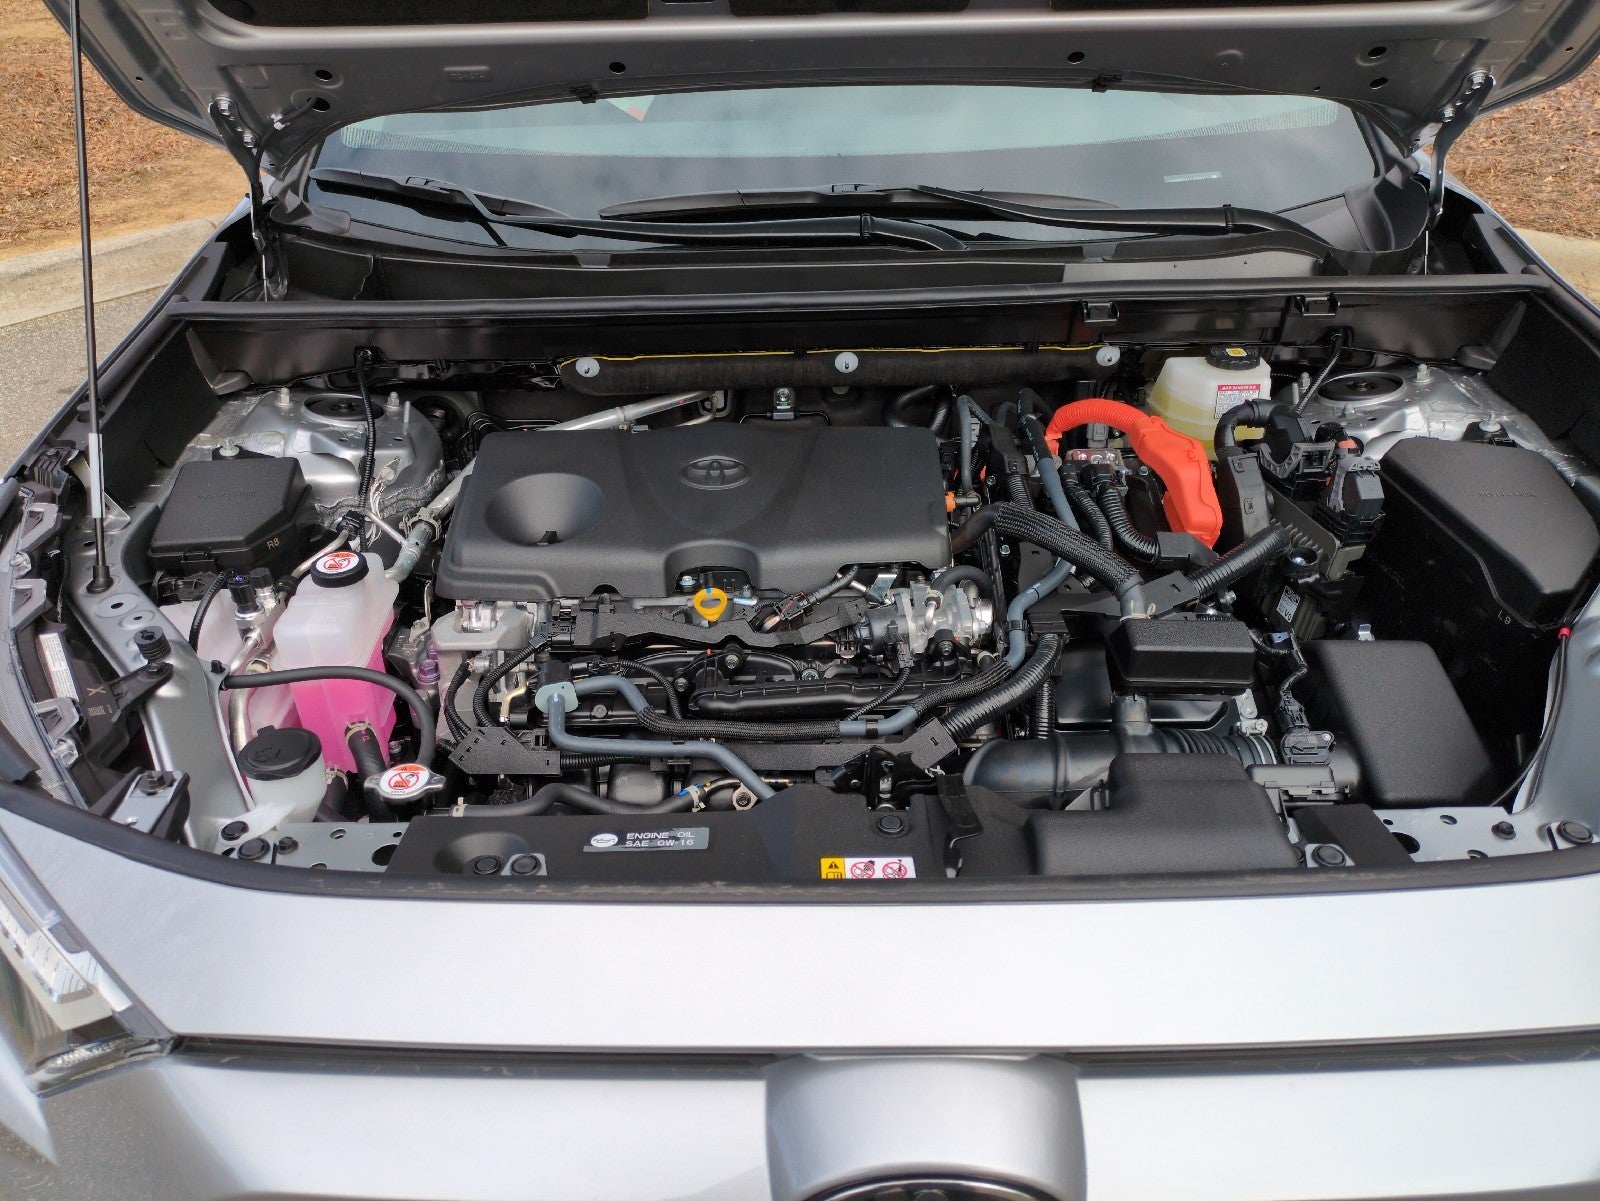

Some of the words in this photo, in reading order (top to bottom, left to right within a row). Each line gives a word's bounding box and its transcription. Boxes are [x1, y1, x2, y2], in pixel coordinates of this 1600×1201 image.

[266, 537, 280, 550] R8
[626, 831, 670, 840] ENGINE
[657, 839, 695, 847] 0W-16
